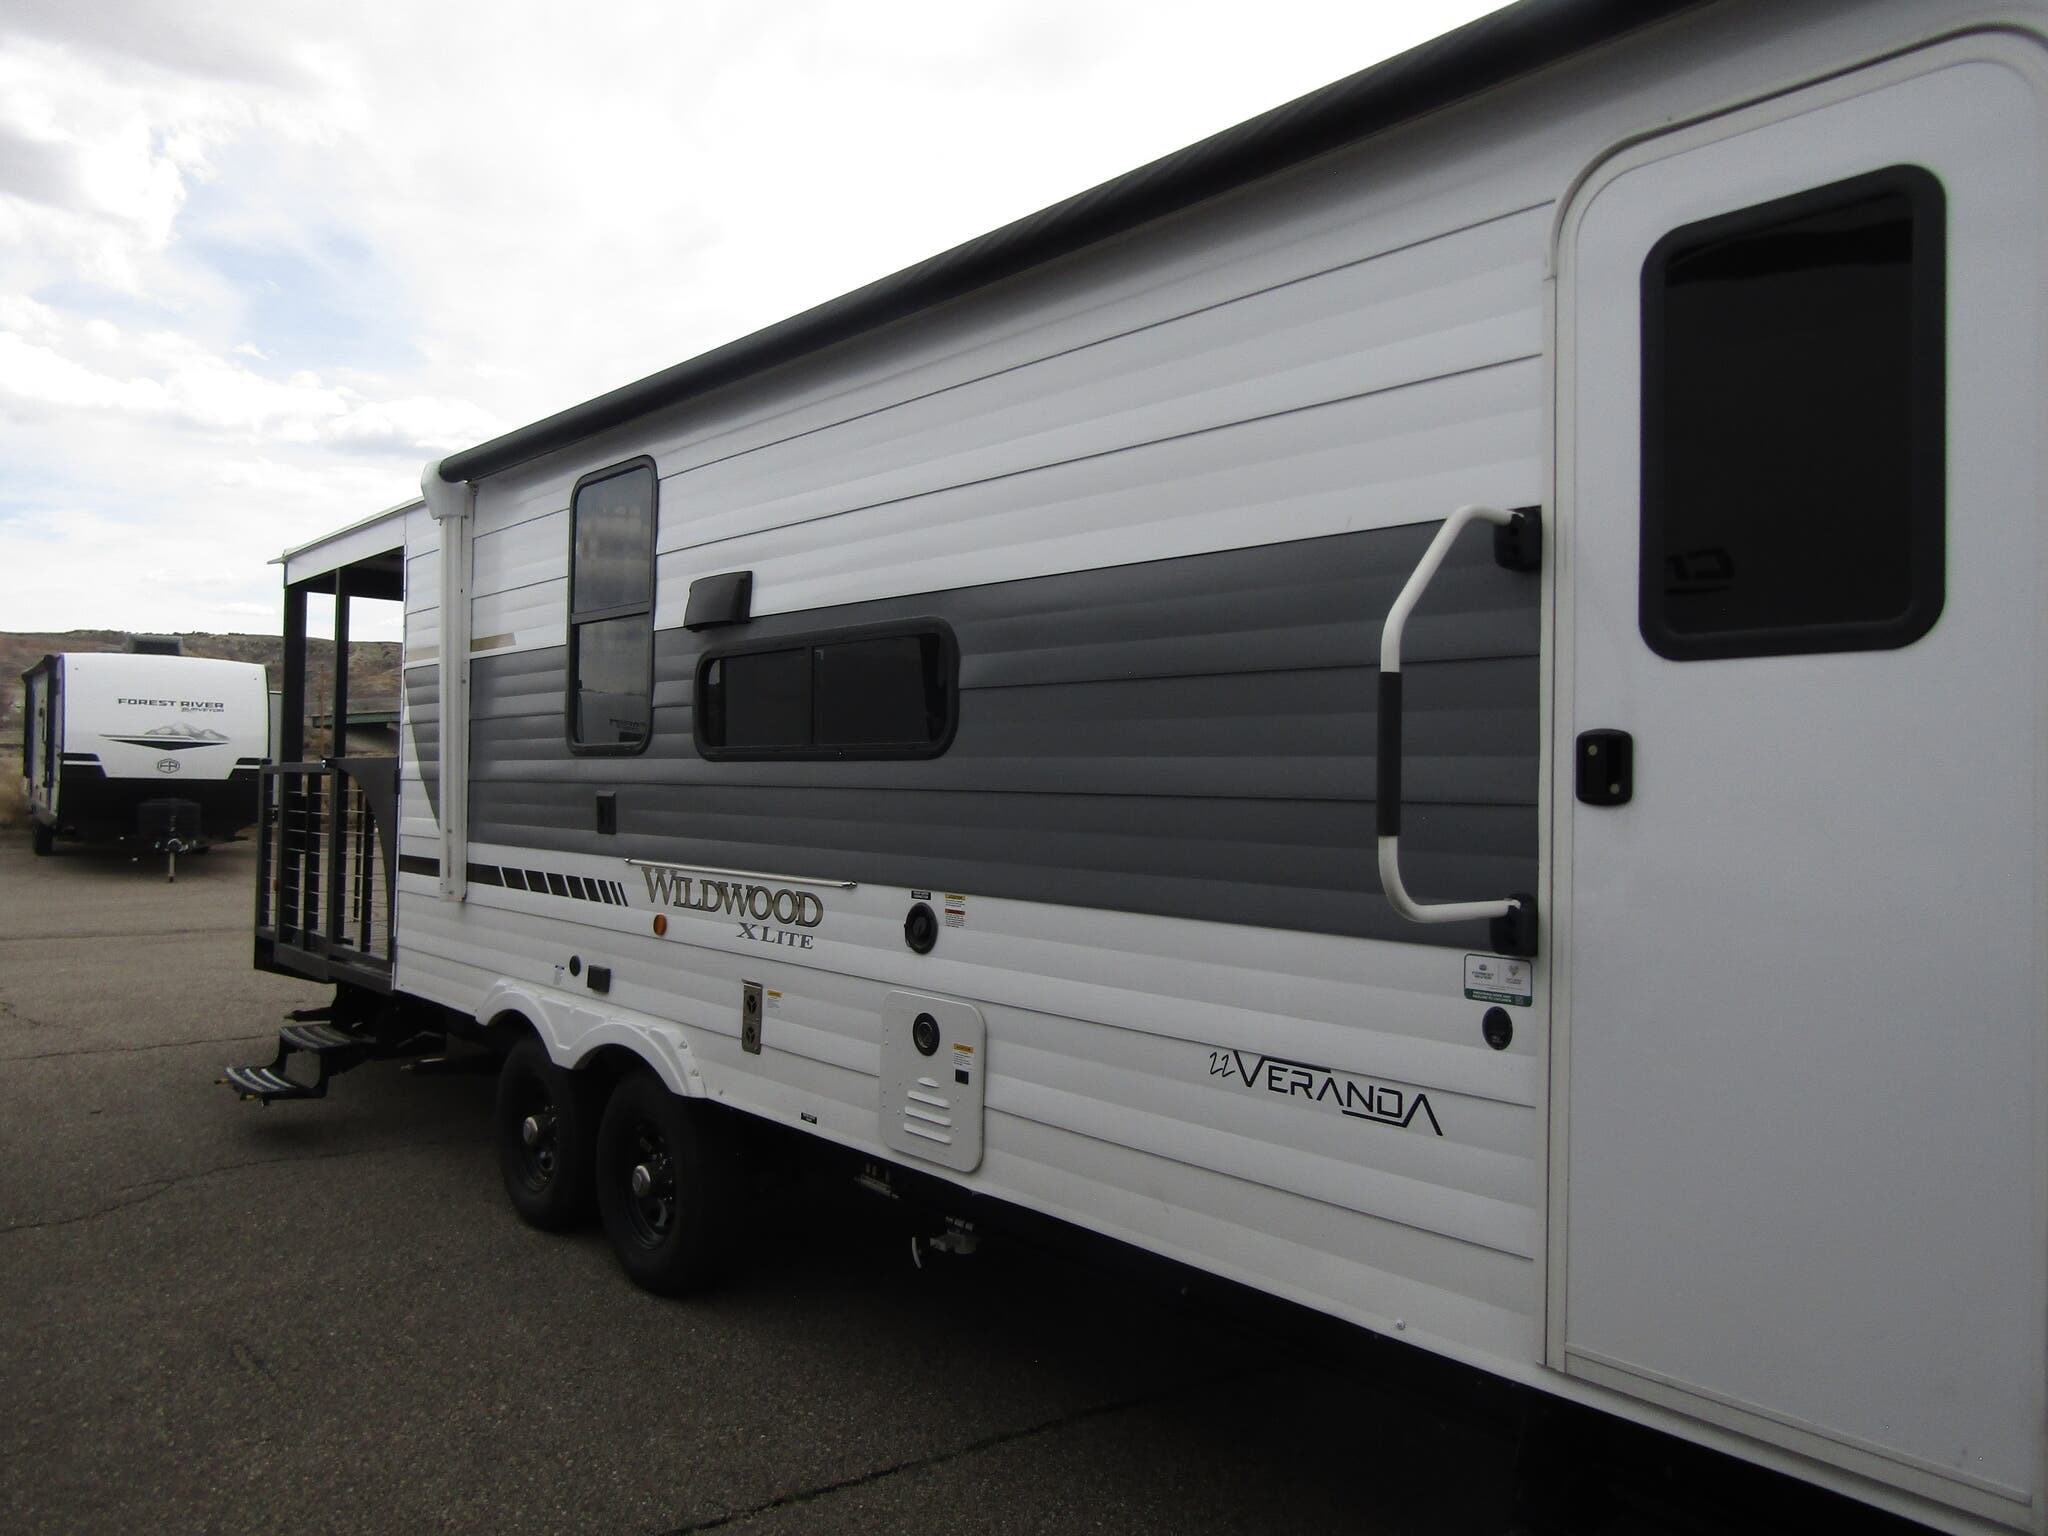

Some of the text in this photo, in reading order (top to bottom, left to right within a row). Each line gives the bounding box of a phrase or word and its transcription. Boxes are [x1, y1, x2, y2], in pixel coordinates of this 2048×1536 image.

[117, 698, 224, 708] FOREST RIVER
[641, 866, 824, 928] WILDWOOD
[1233, 1049, 1443, 1137] VERANDA
